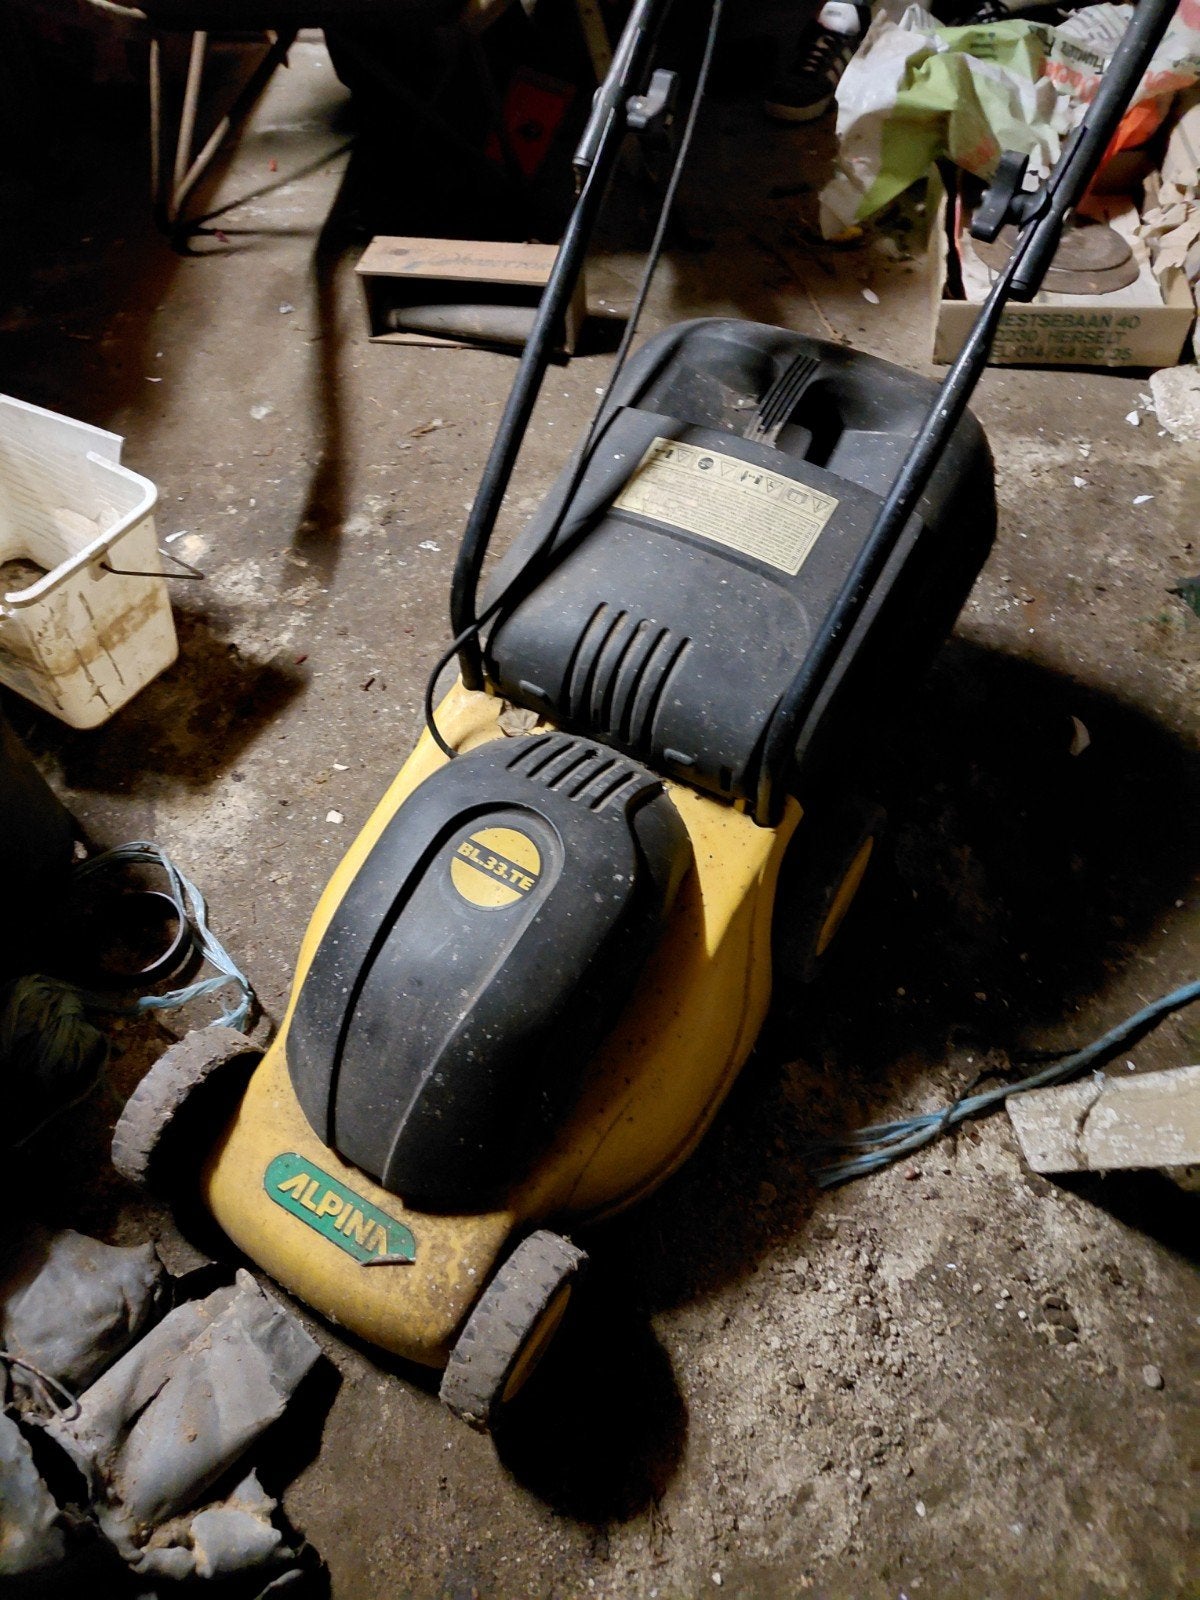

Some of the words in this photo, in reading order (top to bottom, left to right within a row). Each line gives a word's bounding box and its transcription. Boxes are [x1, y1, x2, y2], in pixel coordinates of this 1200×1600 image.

[1000, 312, 1113, 328] ESTSEBAAN
[457, 841, 536, 891] BL.33.TE
[277, 1172, 388, 1255] ALPINA
